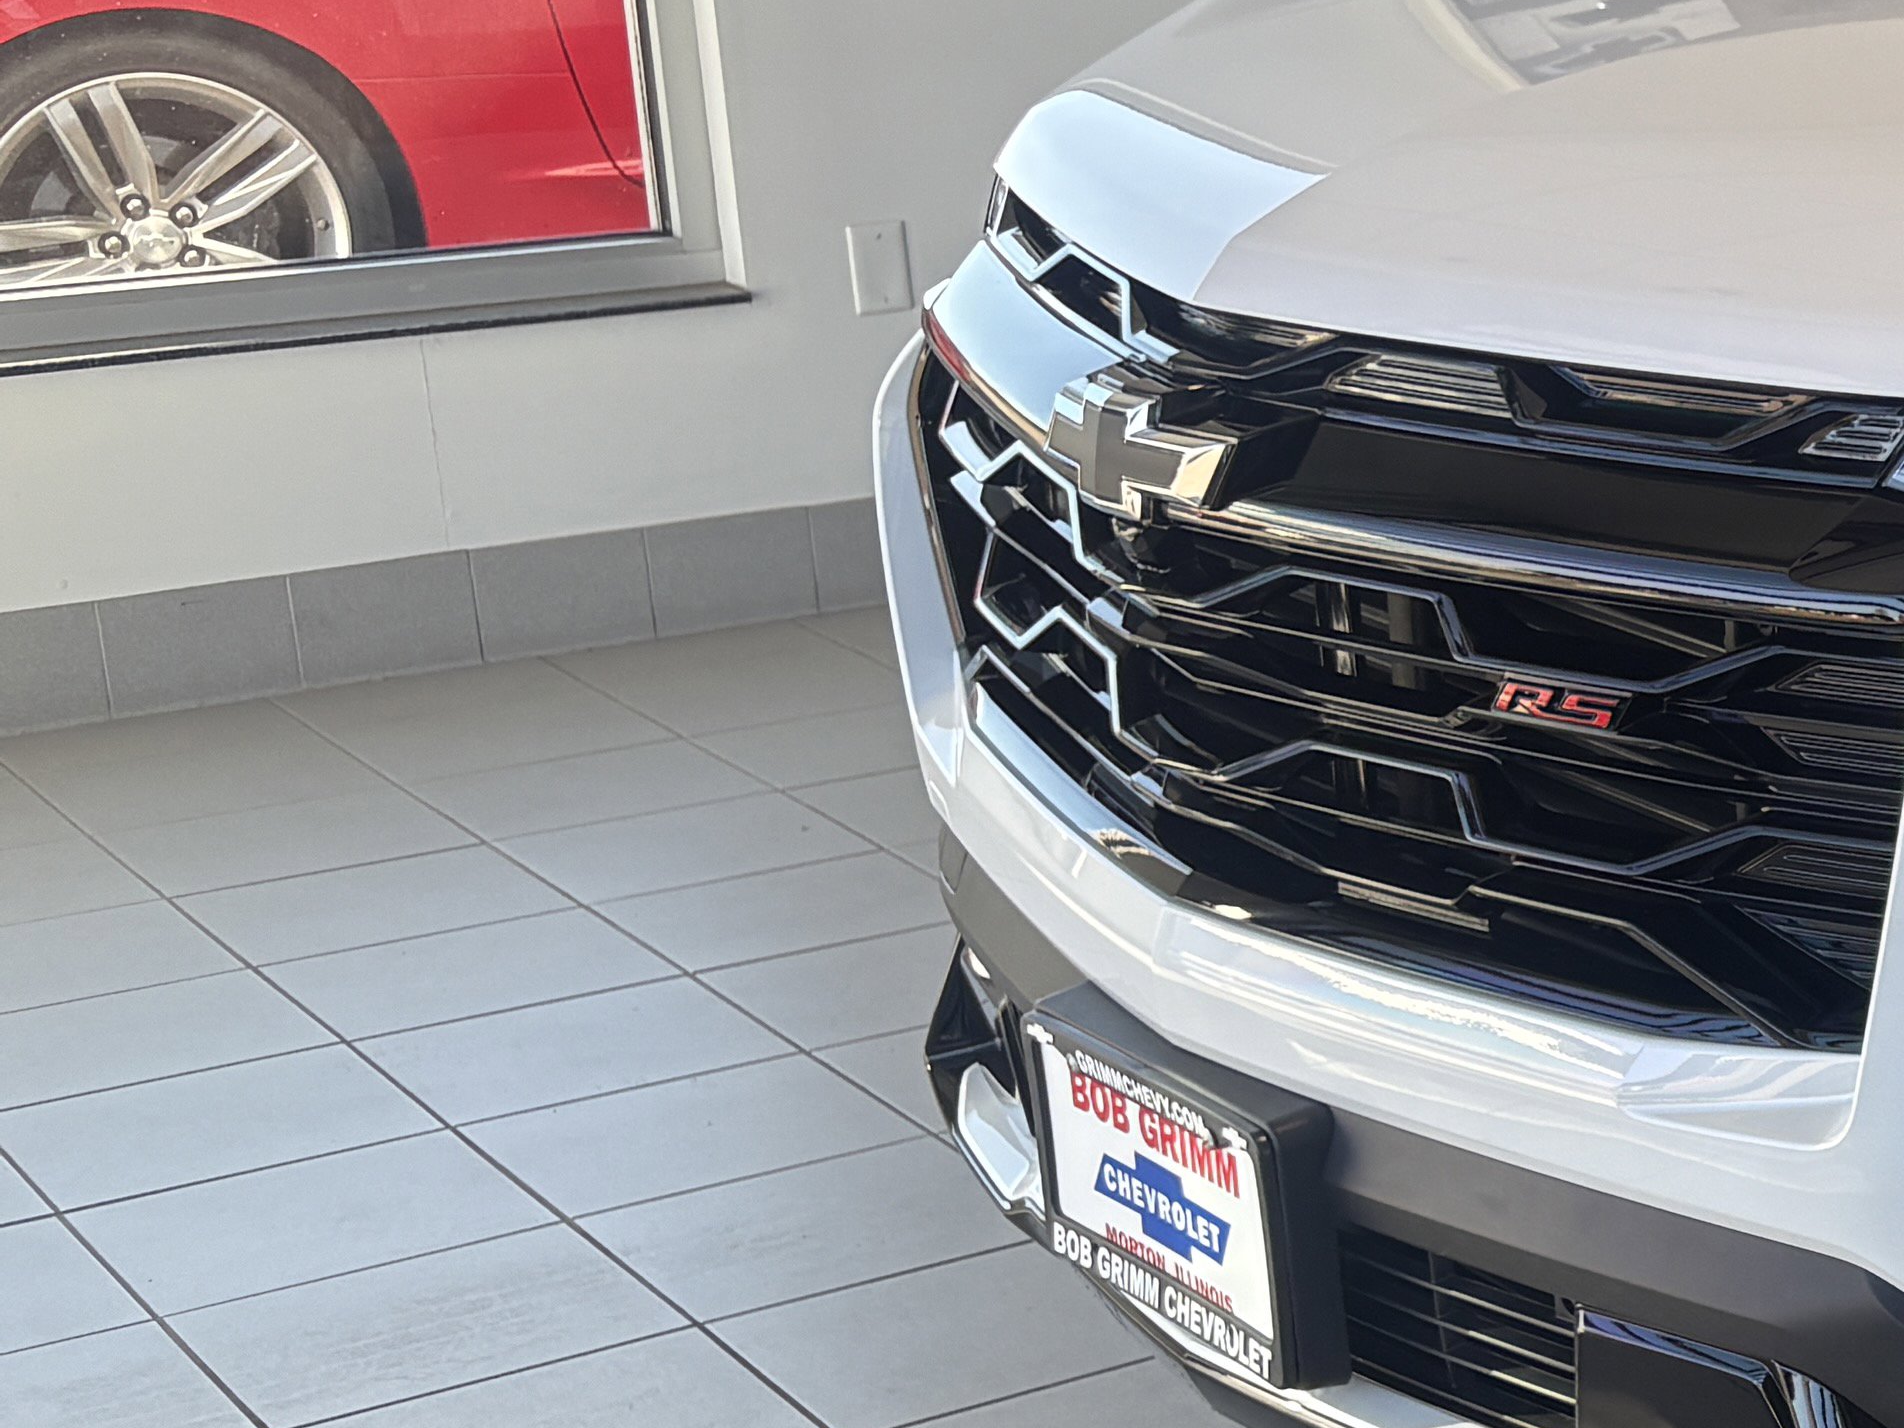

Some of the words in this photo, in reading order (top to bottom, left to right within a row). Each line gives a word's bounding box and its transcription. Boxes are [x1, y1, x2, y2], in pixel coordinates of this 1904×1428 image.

[1496, 682, 1620, 729] RS
[1070, 1072, 1131, 1134] BOB
[1138, 1104, 1241, 1199] GRIMM
[1074, 1049, 1206, 1137] GRIMMCHEVY.COM
[1102, 1162, 1221, 1254] CHEVROLET
[1053, 1221, 1093, 1269] BOB
[1096, 1246, 1160, 1310] GRIMM
[1164, 1285, 1273, 1380] CHEVROLET
[1104, 1222, 1166, 1271] MORTON
[1174, 1261, 1234, 1313] ILLINOIS
